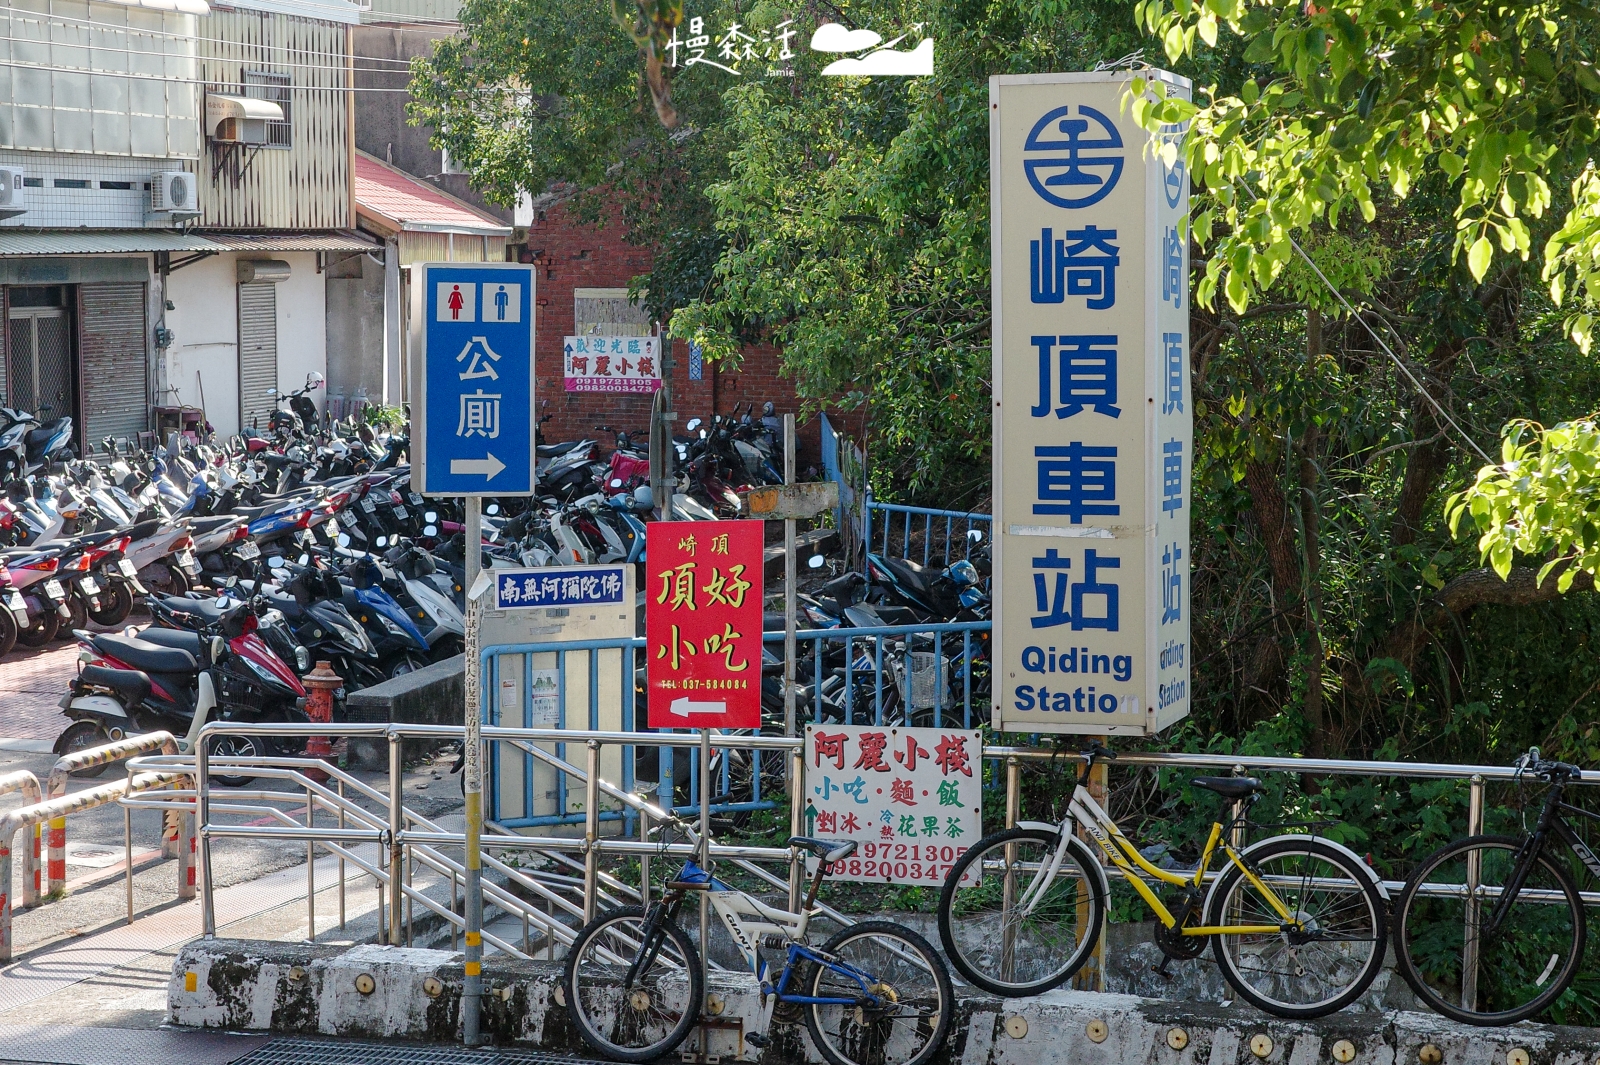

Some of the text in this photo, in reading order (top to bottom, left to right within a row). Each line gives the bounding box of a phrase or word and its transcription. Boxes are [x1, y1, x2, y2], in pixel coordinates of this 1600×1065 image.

[576, 338, 641, 354] 歡迎光臨
[571, 355, 656, 377] 阿麗小棧
[455, 335, 502, 439] 公廁
[1029, 225, 1122, 632] 崎頂車站
[1162, 225, 1184, 626] 崎頂車站
[678, 533, 730, 558] 崎頂
[500, 572, 622, 604] 南無阿彌陀佛
[656, 562, 752, 612] 頂好
[656, 623, 749, 673] 小吃
[1021, 646, 1133, 682] Qiding
[1159, 639, 1185, 671] Qiding
[1158, 677, 1185, 710] Station
[813, 730, 973, 778] 阿麗小棧
[1103, 843, 1121, 860] BIKE
[725, 913, 754, 952] GIANT
